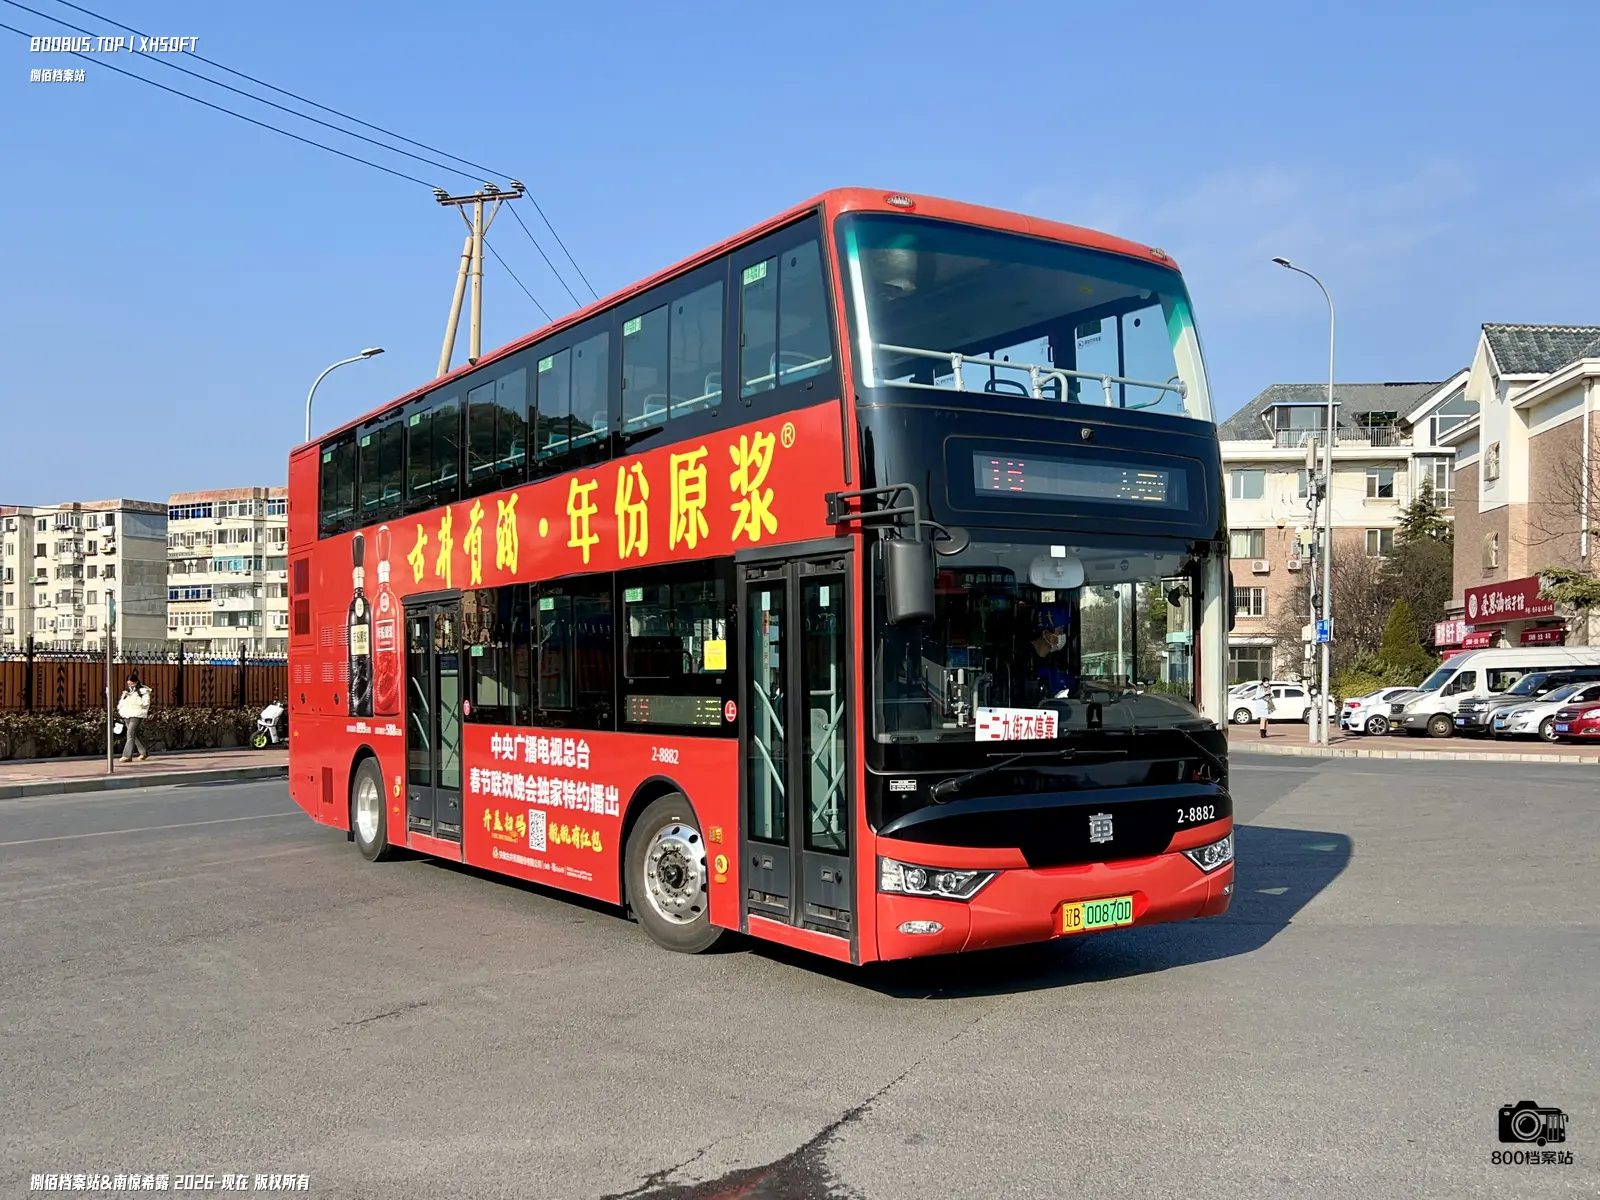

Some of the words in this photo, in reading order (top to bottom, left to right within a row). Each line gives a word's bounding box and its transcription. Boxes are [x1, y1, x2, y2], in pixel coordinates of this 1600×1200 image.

[979, 714, 1054, 741] 一二九街不停靠
[491, 731, 590, 770] 中央广播电视总台
[651, 746, 679, 765] 2-8882
[470, 767, 620, 817] 春节联欢晚会独家特约播出
[1177, 804, 1215, 824] 2-8882
